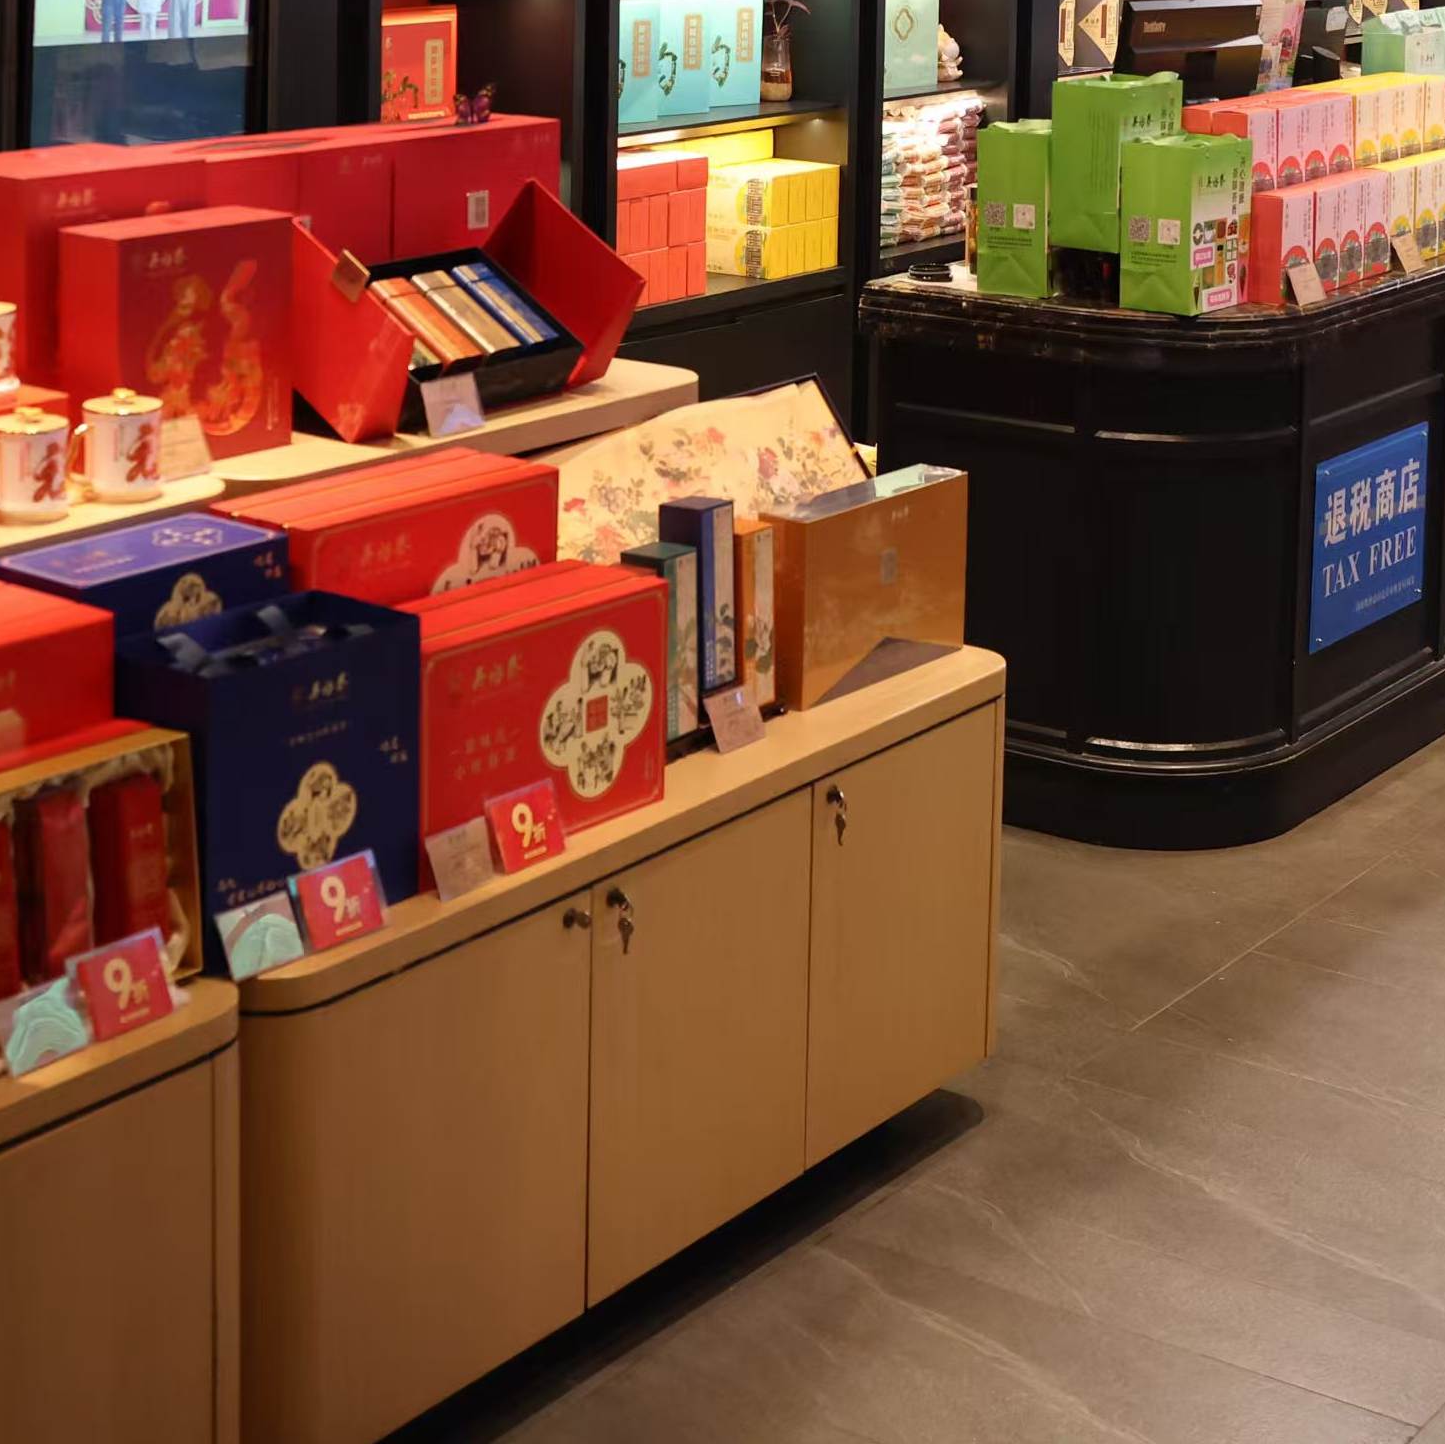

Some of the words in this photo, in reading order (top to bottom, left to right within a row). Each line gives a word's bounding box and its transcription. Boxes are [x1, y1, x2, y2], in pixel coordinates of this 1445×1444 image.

[1323, 458, 1420, 548] 退税商店
[1322, 551, 1361, 598] TAX
[1368, 526, 1417, 577] FREE
[511, 802, 547, 849] 9折
[320, 875, 364, 923] 9折
